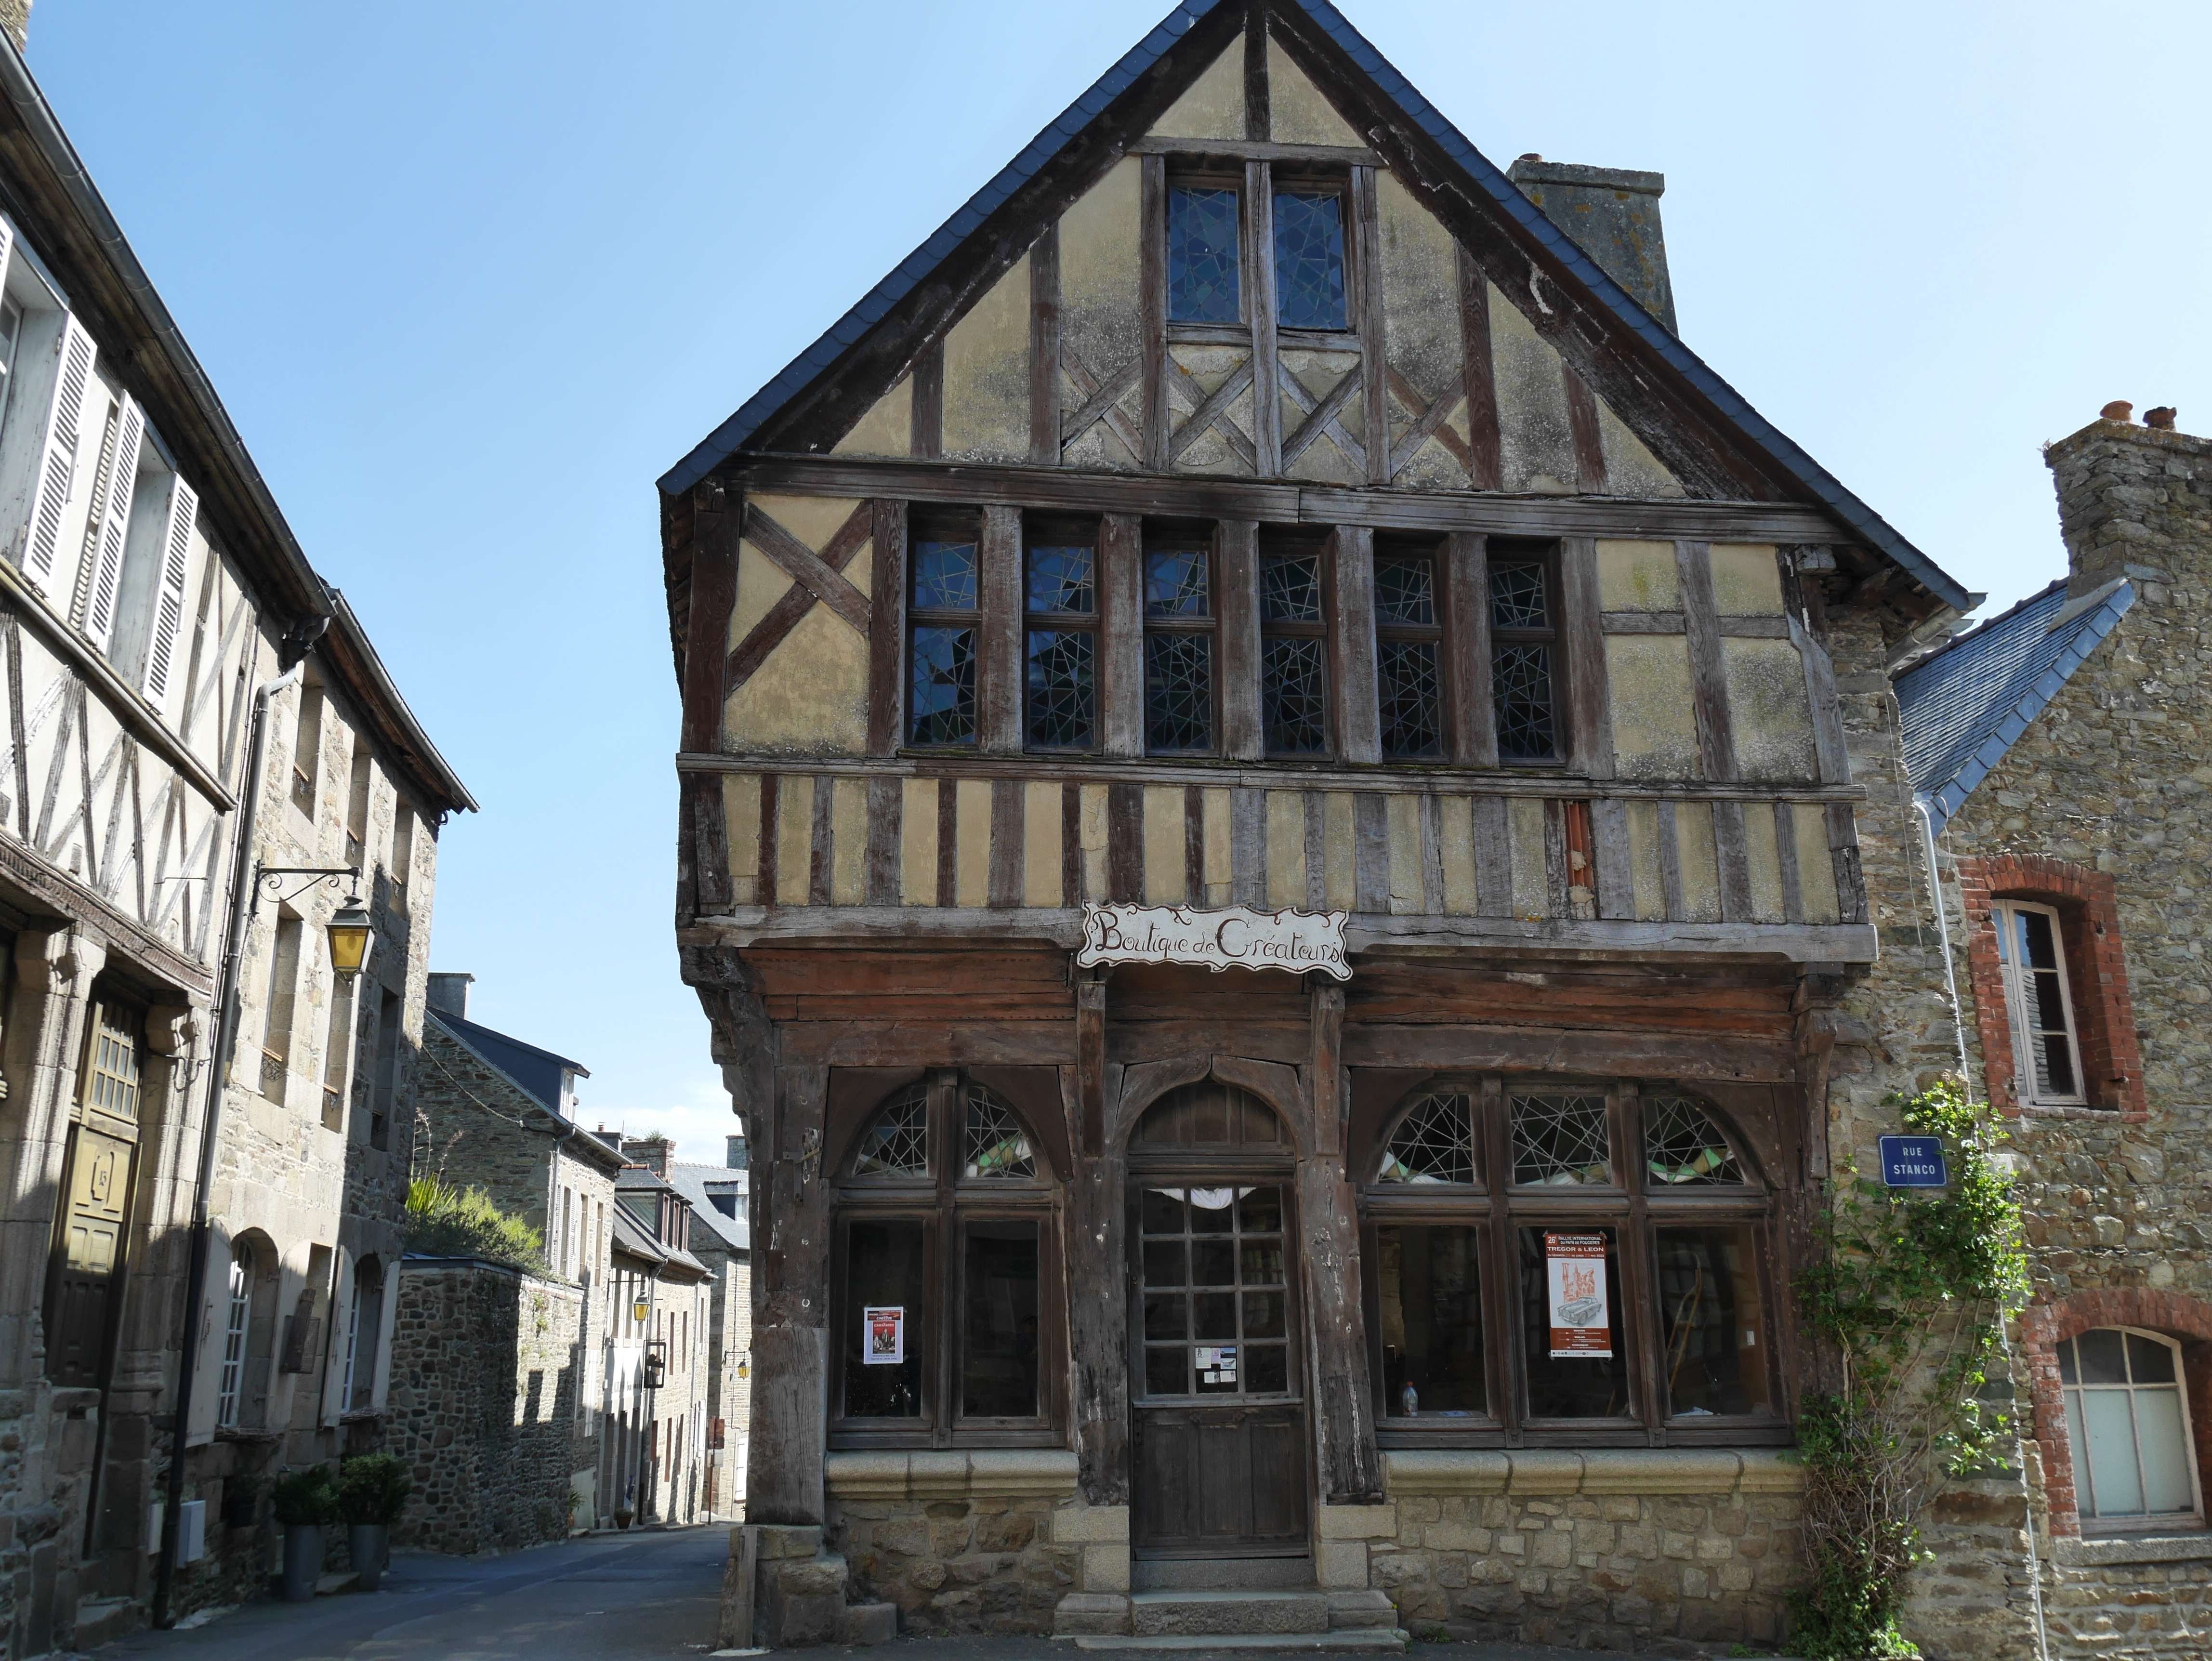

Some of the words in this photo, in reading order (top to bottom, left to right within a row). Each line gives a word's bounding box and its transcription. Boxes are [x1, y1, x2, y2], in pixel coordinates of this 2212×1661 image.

[1092, 911, 1189, 958] Boutique
[1193, 932, 1215, 954] de
[1215, 918, 1340, 962] Créateurs
[1903, 1147, 1922, 1156] RUE
[1894, 1164, 1935, 1174] STANCO
